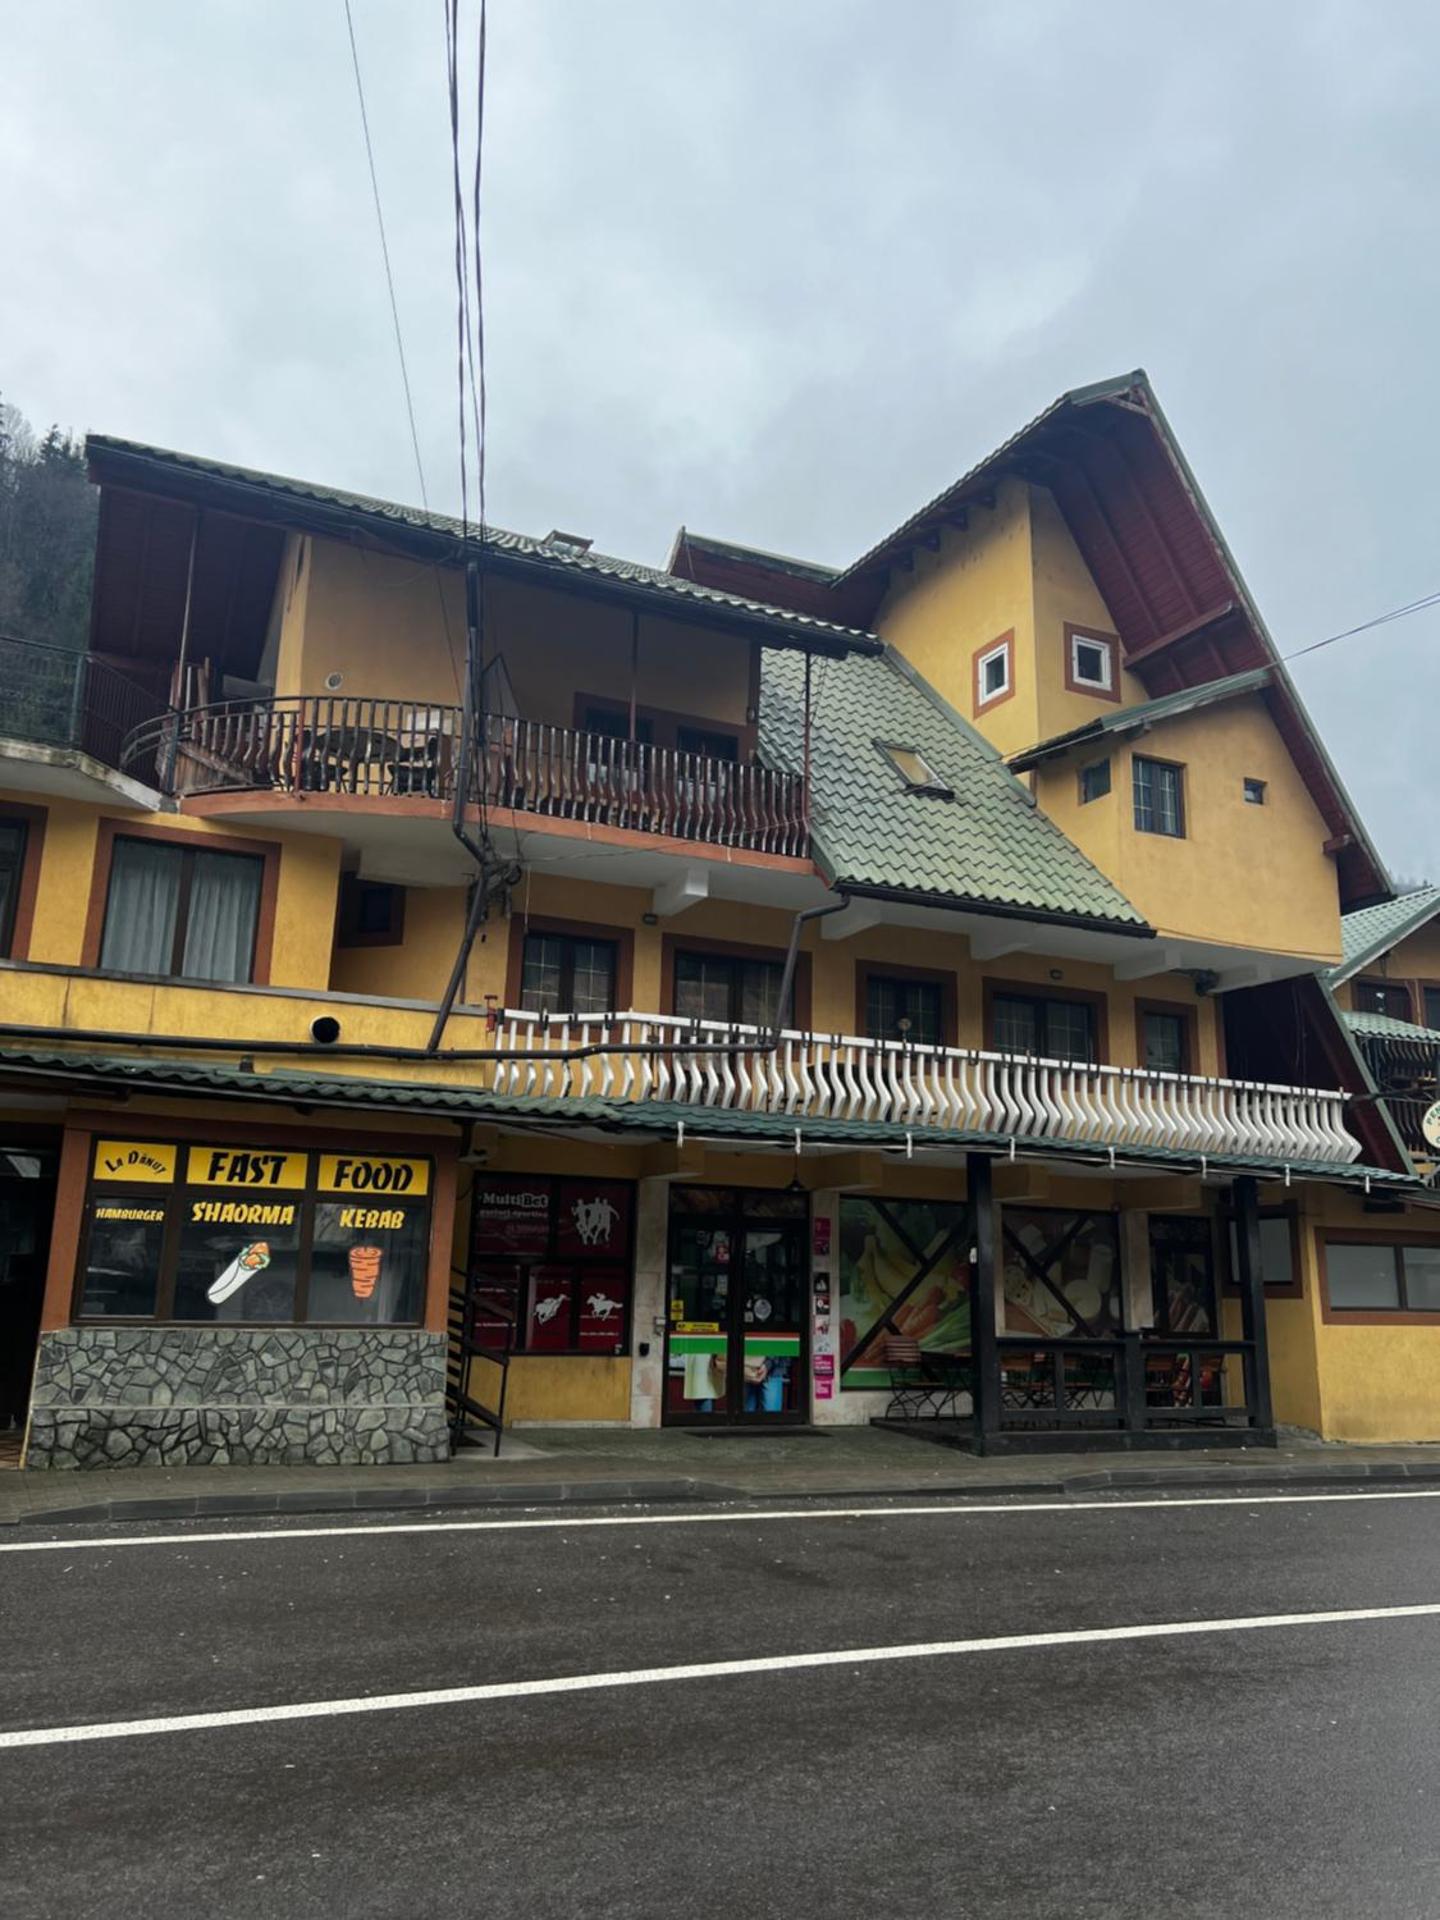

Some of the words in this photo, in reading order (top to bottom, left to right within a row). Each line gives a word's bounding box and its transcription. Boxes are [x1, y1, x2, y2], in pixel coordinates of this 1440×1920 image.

[208, 1152, 287, 1184] FAST
[333, 1160, 413, 1191] FOOD
[482, 1192, 549, 1209] MultiBet
[96, 1208, 165, 1221] HAMBURGER
[192, 1202, 295, 1225] SHAORMA
[340, 1208, 405, 1229] KEBAB
